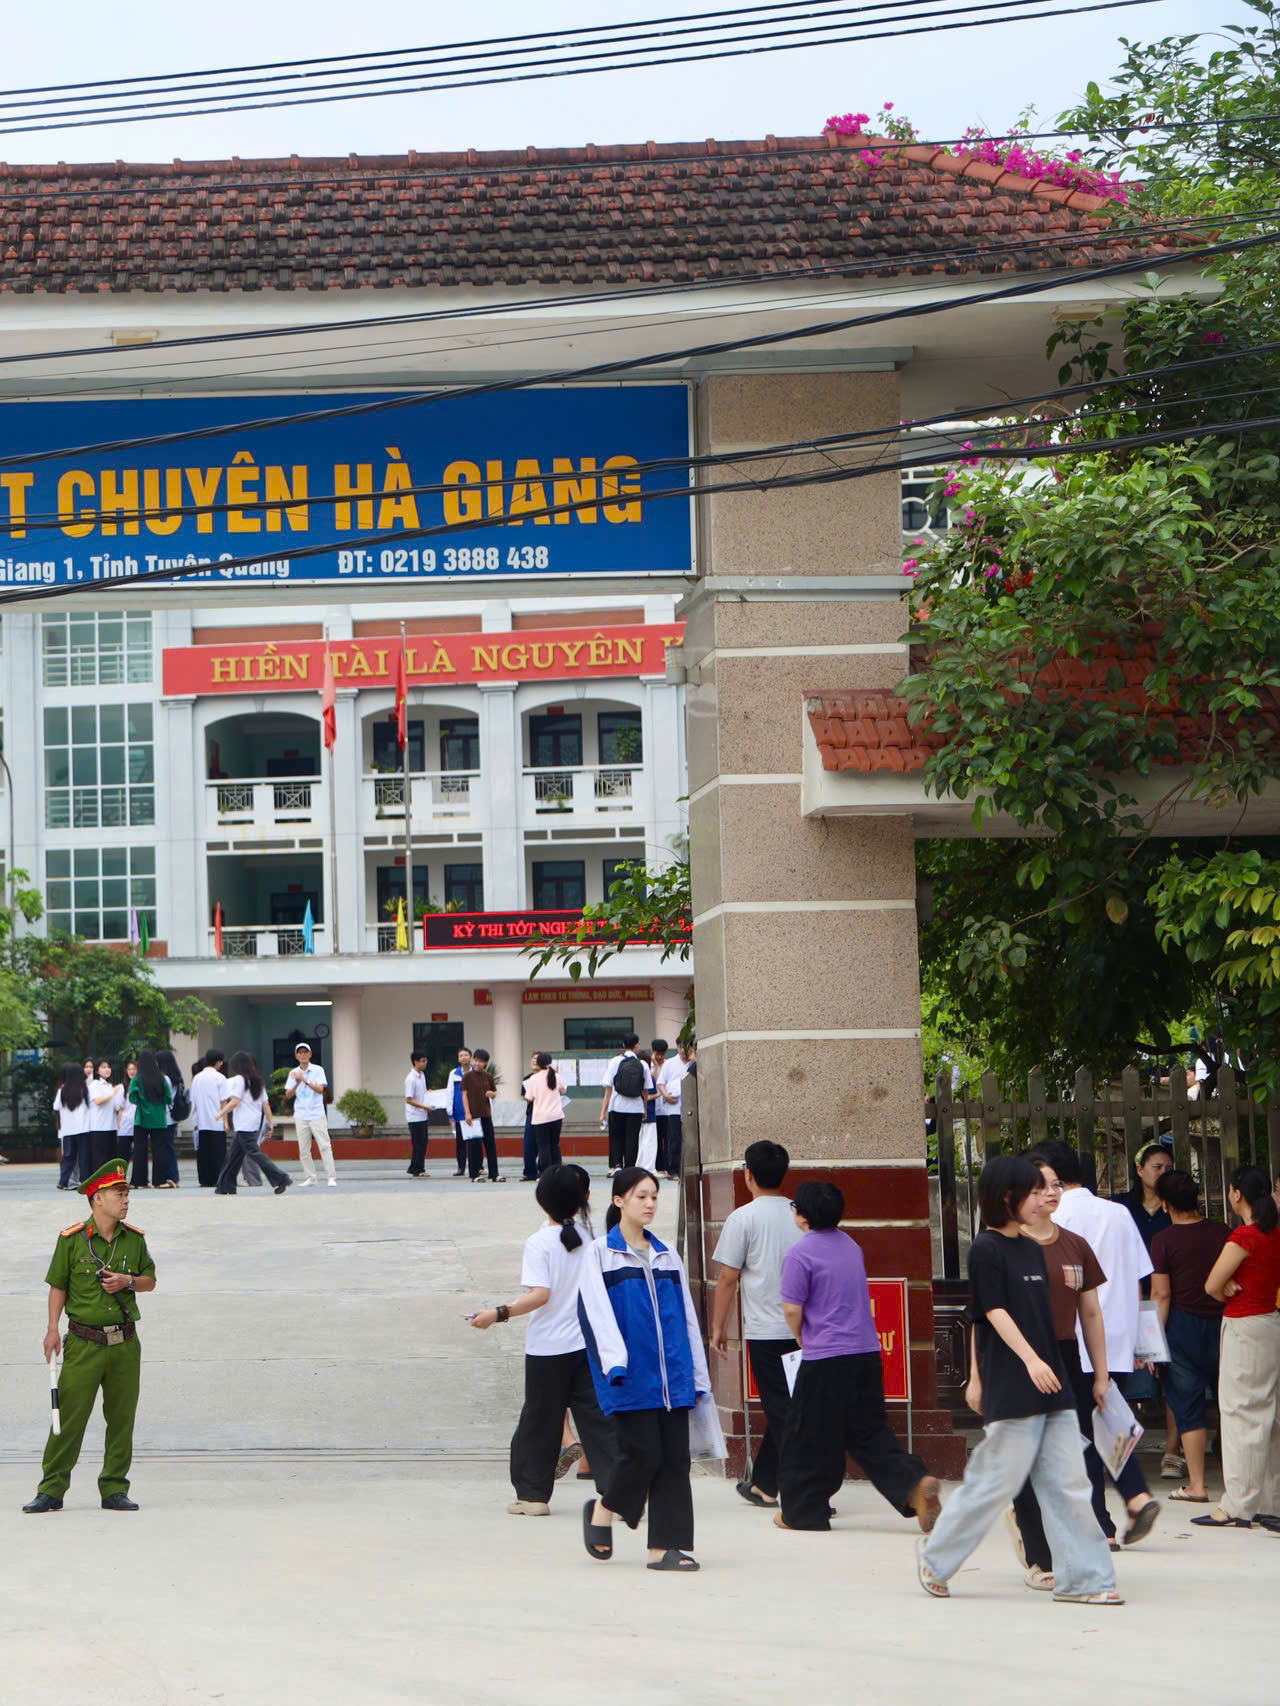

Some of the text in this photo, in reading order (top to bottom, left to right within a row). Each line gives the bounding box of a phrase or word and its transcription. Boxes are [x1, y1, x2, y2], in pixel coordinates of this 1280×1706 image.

[58, 451, 308, 536] CHUYÊN
[333, 446, 421, 531] HÀ
[443, 454, 642, 525] GIANG
[63, 556, 84, 580] 1,
[90, 553, 139, 580] Tỉnh
[145, 553, 211, 581] Tuyên
[219, 552, 290, 579] Quang
[338, 550, 373, 574] ĐT:
[380, 548, 437, 573] 0219
[443, 547, 499, 572] 3888
[507, 545, 549, 570] 438
[210, 643, 309, 684] HIỀN
[324, 643, 389, 678] TÀI
[405, 639, 457, 675] LÀ
[471, 633, 645, 673] NGUYÊN
[478, 923, 504, 937] THI
